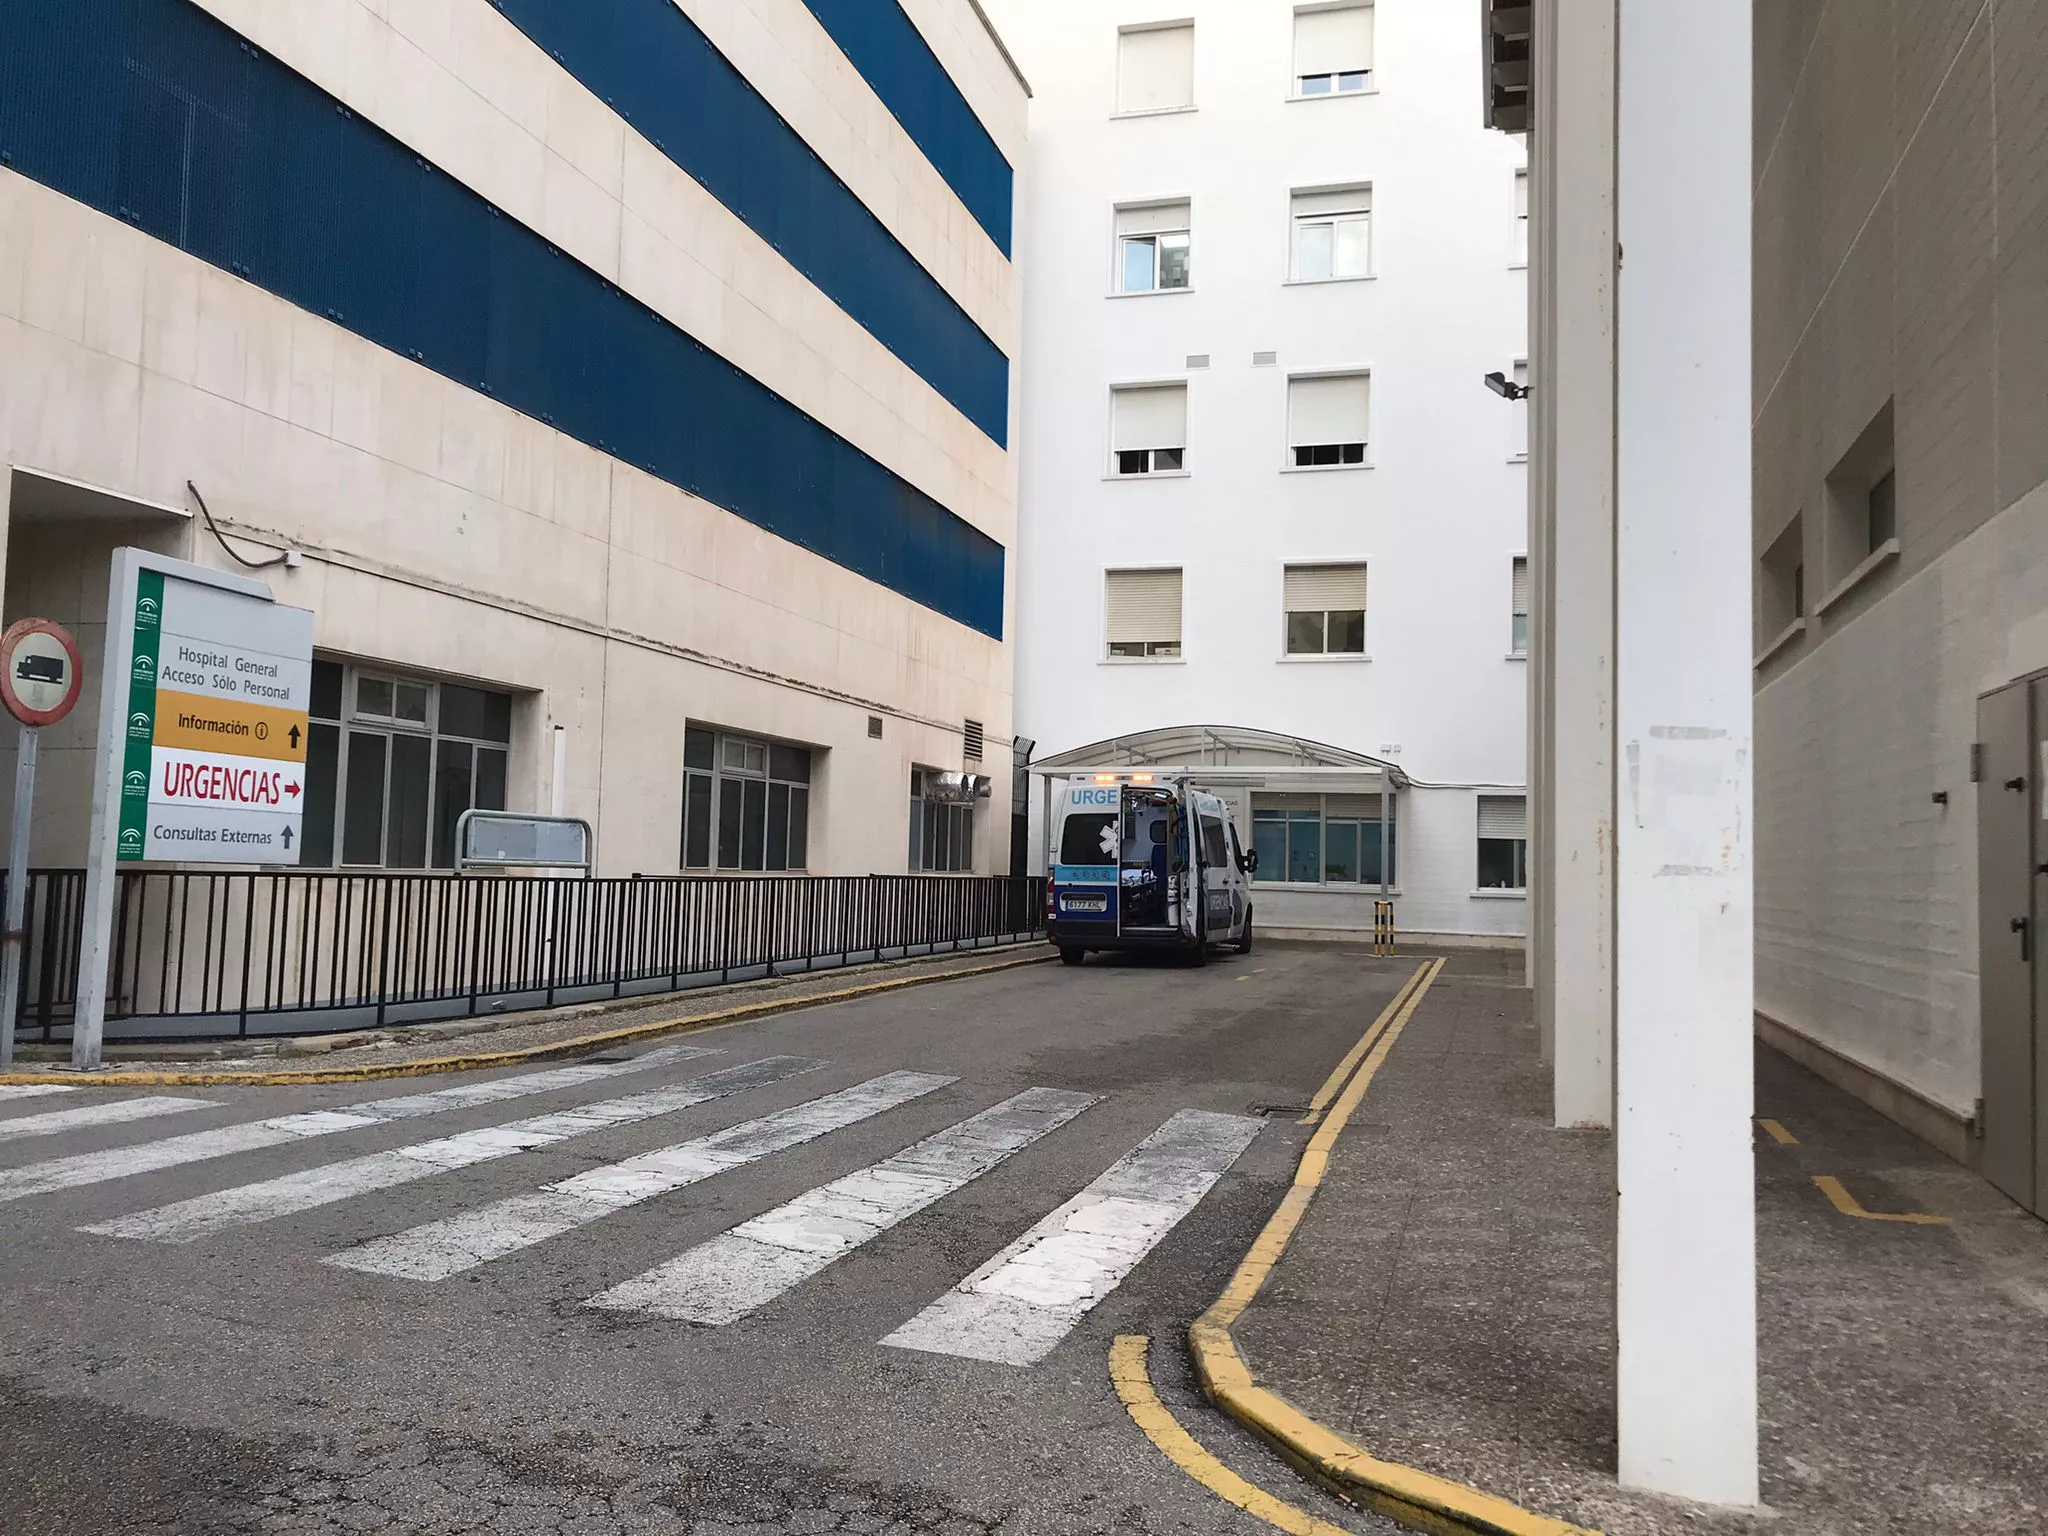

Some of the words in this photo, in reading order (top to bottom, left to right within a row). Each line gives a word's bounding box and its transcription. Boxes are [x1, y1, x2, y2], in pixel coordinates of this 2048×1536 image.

[178, 646, 228, 669] Hospital
[235, 657, 278, 678] General
[161, 665, 205, 686] Acceso
[212, 673, 237, 691] Sólo
[243, 679, 290, 700] Personal
[178, 713, 249, 736] Información
[163, 761, 281, 805] URGENCIAS
[1071, 789, 1117, 805] URGE
[153, 824, 217, 842] Consultas
[220, 828, 272, 845] Externas
